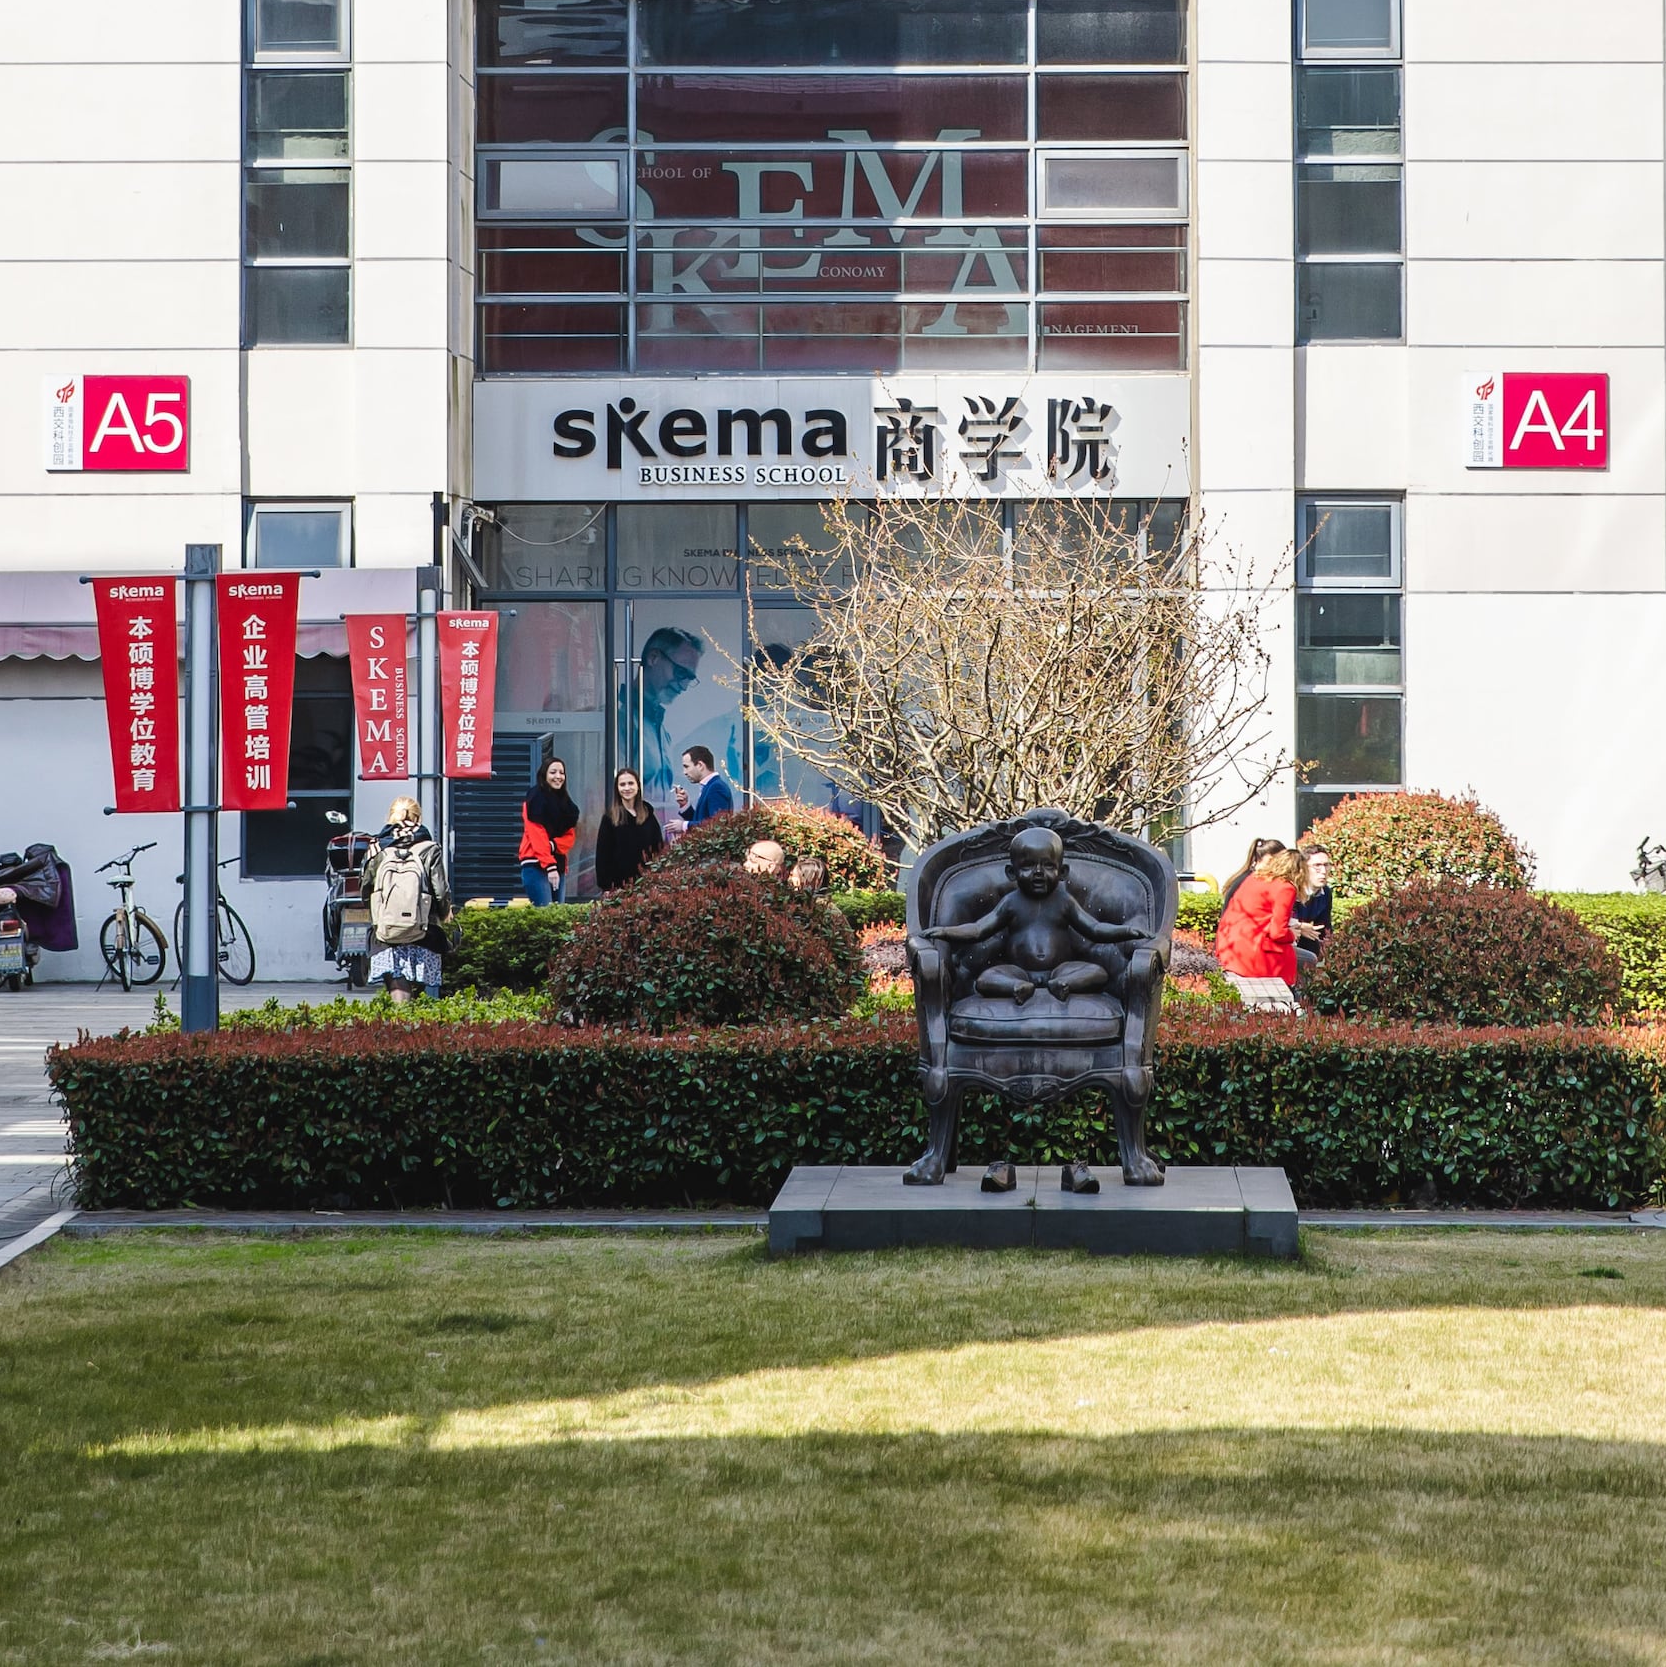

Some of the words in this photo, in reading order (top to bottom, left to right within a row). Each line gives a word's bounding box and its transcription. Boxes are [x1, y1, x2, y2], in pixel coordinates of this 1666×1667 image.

[692, 167, 712, 179] OF
[89, 392, 183, 454] A5
[553, 397, 847, 470] skema
[874, 396, 1114, 482] 商学院
[1509, 390, 1603, 451] A4
[640, 466, 745, 483] BUSINESS
[756, 467, 846, 483] SCHOOL
[109, 585, 165, 600] skema
[228, 584, 283, 598] skema
[449, 618, 490, 629] skema
[128, 616, 156, 792] 本硕博学位教育
[242, 614, 271, 790] 企业高管培训
[365, 626, 392, 773] SKEMA
[395, 667, 405, 720] BUSINESS
[456, 641, 480, 768] 本硕博学位教育
[395, 727, 406, 774] SCHOOL
